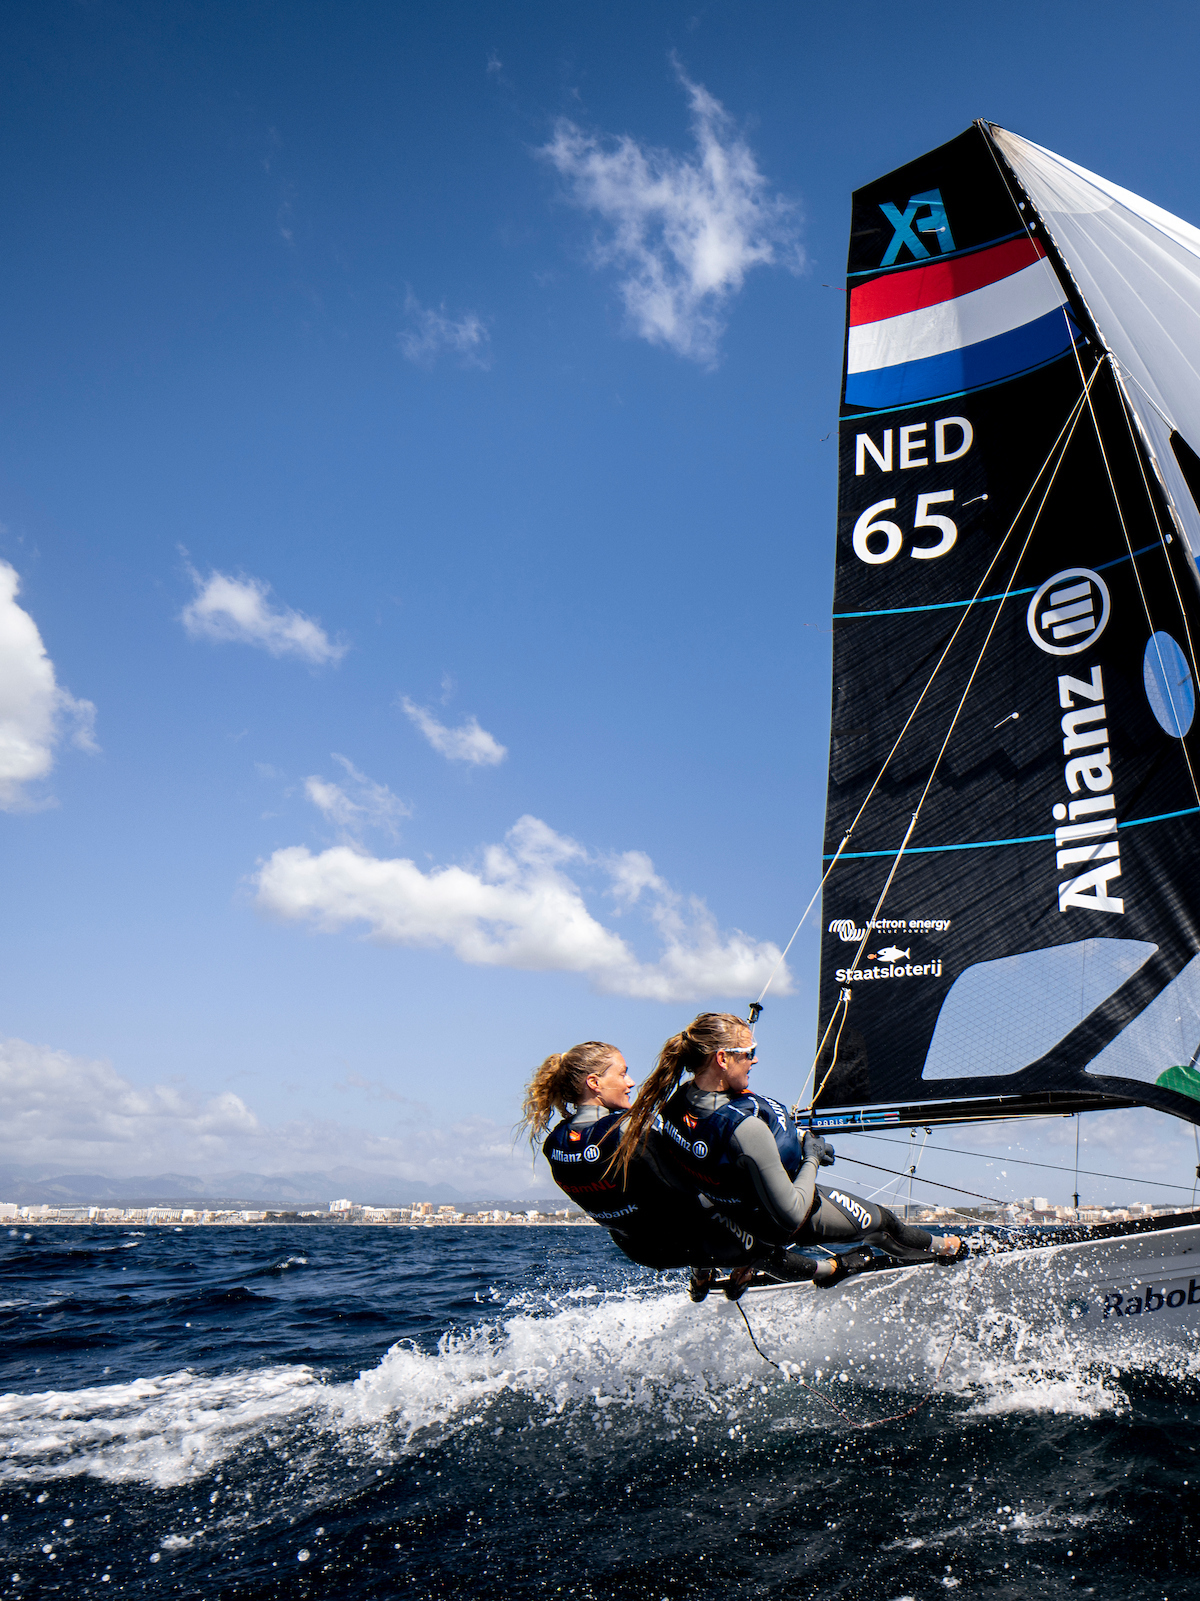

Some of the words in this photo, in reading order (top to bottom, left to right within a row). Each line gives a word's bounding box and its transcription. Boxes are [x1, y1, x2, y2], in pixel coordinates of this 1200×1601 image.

[855, 416, 973, 476] NED
[852, 489, 958, 565] 65
[1052, 665, 1125, 914] Allianz
[865, 918, 907, 929] victron
[908, 919, 951, 931] energy
[835, 959, 942, 982] Staatsloterij
[664, 1119, 692, 1152] Allianz
[551, 1148, 582, 1163] Allianz
[828, 1190, 872, 1229] MUSTO
[711, 1212, 754, 1250] MUSTO
